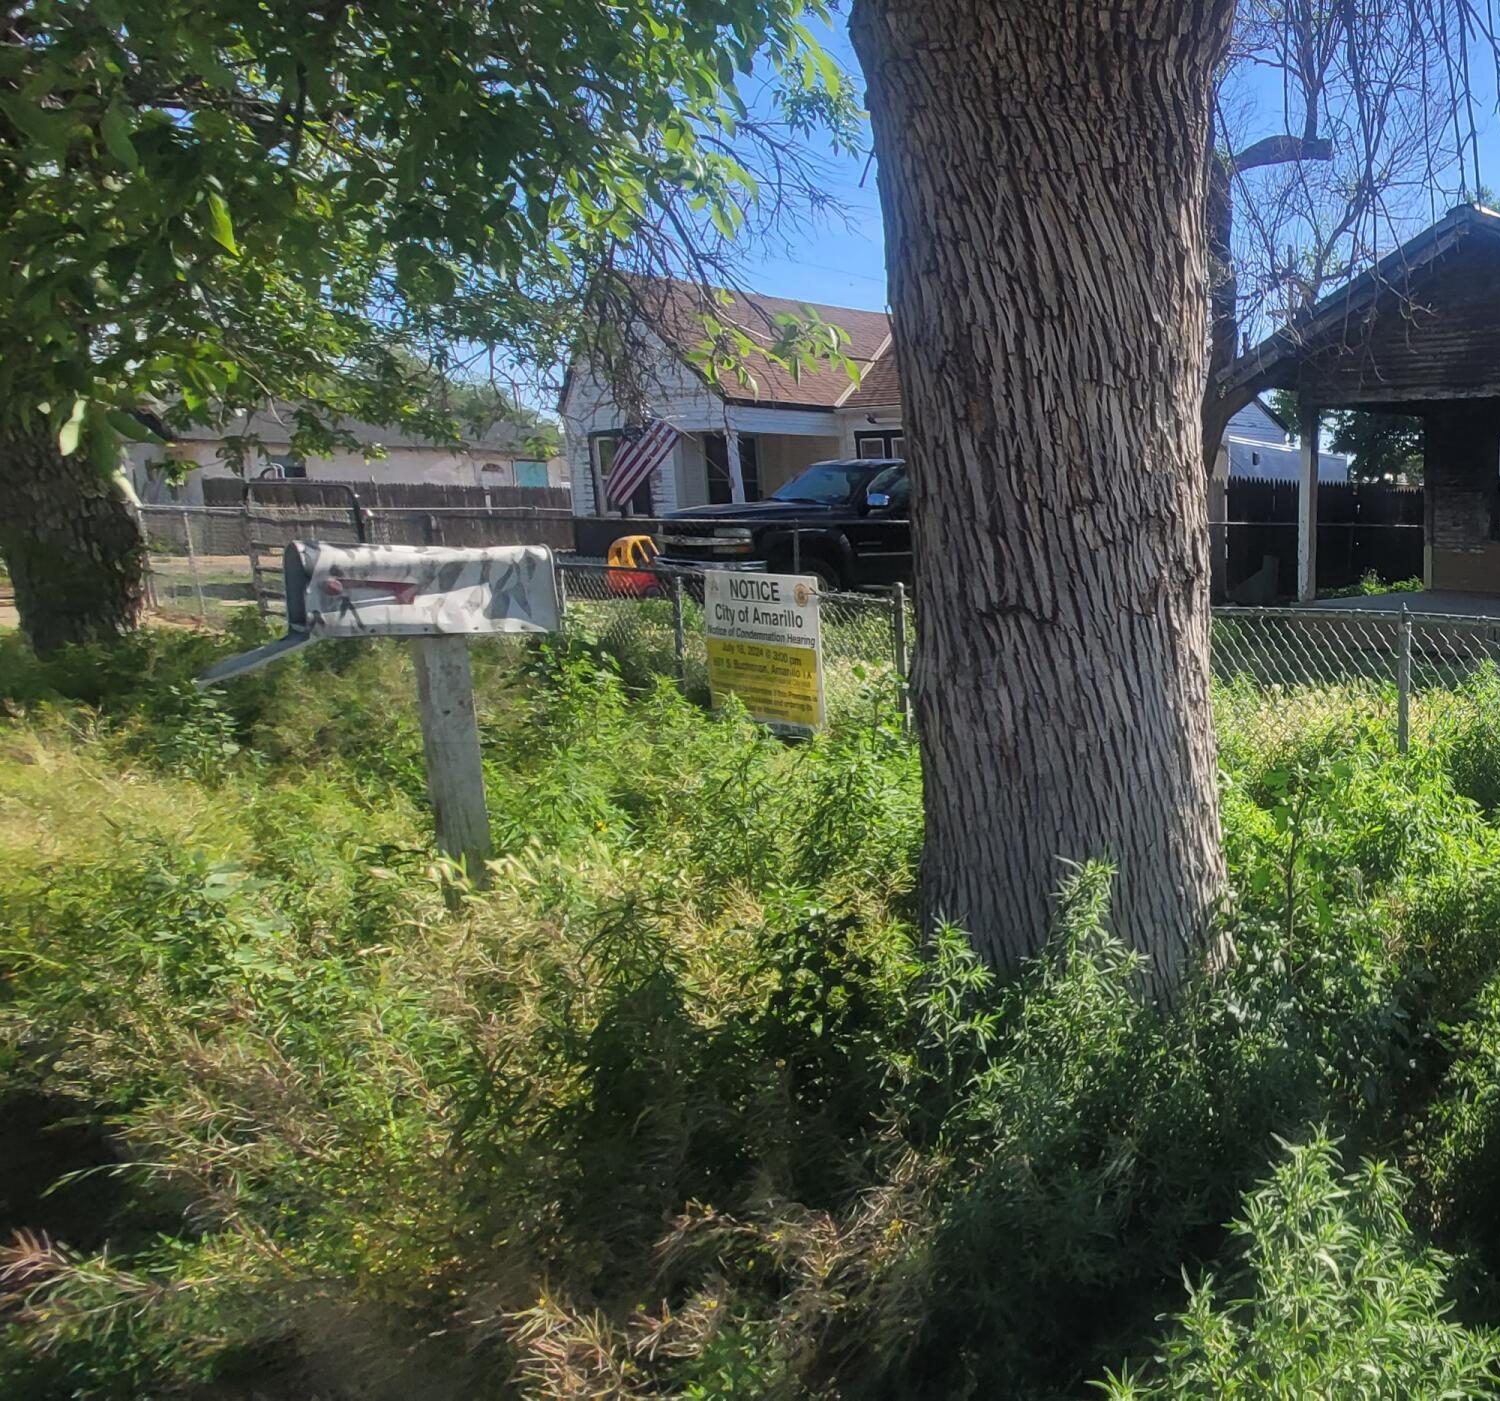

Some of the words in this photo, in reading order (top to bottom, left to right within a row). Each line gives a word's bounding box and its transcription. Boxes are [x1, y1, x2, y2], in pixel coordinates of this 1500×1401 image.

[729, 579, 781, 601] NOTICE
[715, 603, 735, 626] City
[738, 605, 749, 623] of
[752, 607, 803, 628] Amarillo
[728, 627, 735, 637] of
[736, 628, 786, 643] Condemnation
[787, 633, 816, 648] Hearing
